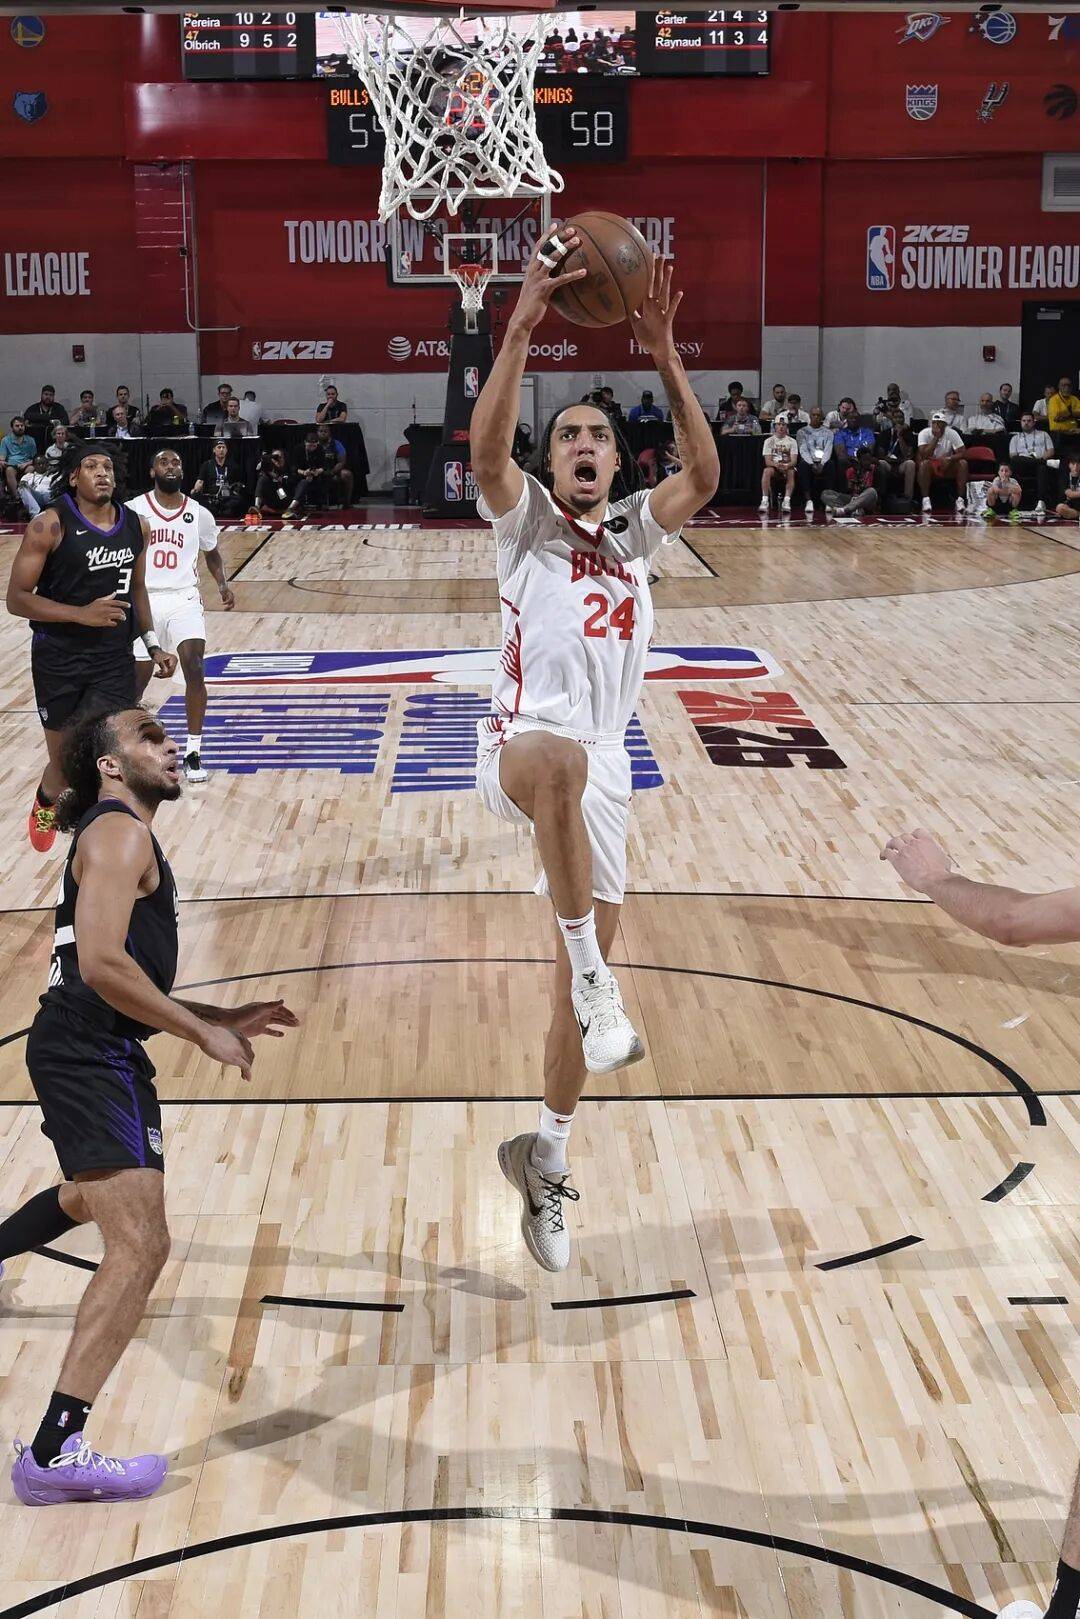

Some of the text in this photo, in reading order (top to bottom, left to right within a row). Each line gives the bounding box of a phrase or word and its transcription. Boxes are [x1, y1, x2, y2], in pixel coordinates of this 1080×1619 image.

[183, 12, 296, 28] Pereira 10 2 0
[655, 10, 768, 25] Carter 21 4 3
[183, 32, 297, 50] Olbrich 9 5 2
[185, 30, 199, 41] 47
[655, 30, 768, 49] Raynaud 11 3 4
[658, 27, 672, 38] 42
[330, 89, 369, 106] BULLS
[534, 87, 573, 104] KINGS
[570, 111, 614, 147] 58
[284, 218, 449, 263] TOMORRWS
[460, 217, 538, 261] TARS
[901, 225, 970, 243] 2K26
[4, 251, 92, 297] LEAGUE
[901, 245, 1080, 290] SUMMER LEAGU
[870, 275, 886, 286] NBA
[261, 340, 335, 360] 2K26
[414, 340, 450, 357] AT&
[528, 338, 578, 361] oogle
[629, 338, 704, 358] Hessy
[150, 528, 184, 549] BULLS
[86, 545, 135, 572] Kings
[153, 549, 178, 570] 00
[116, 568, 132, 594] 3
[583, 592, 635, 641] 24
[677, 690, 848, 770] 2K26
